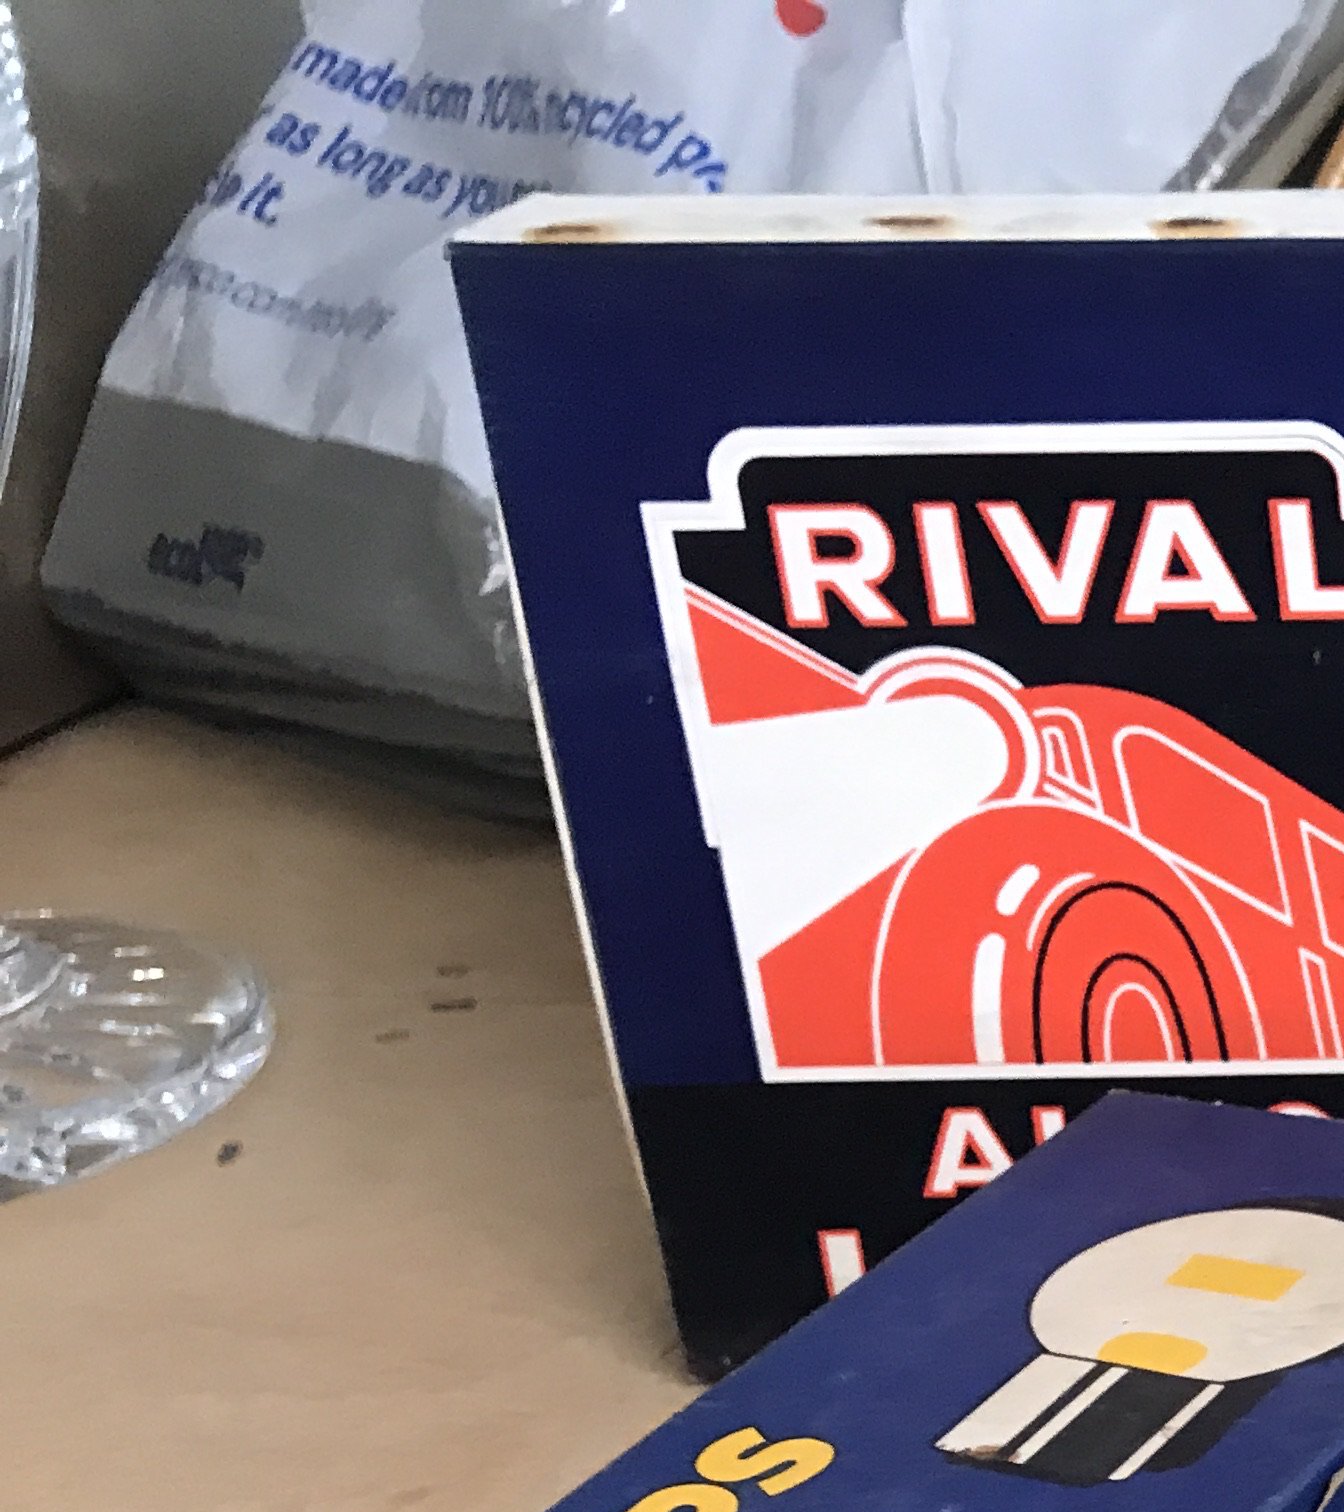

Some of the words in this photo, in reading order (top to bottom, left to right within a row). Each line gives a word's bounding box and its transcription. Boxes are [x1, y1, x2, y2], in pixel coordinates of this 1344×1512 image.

[291, 41, 407, 110] made
[265, 112, 321, 156] as
[318, 126, 407, 196] long
[402, 162, 452, 201] as
